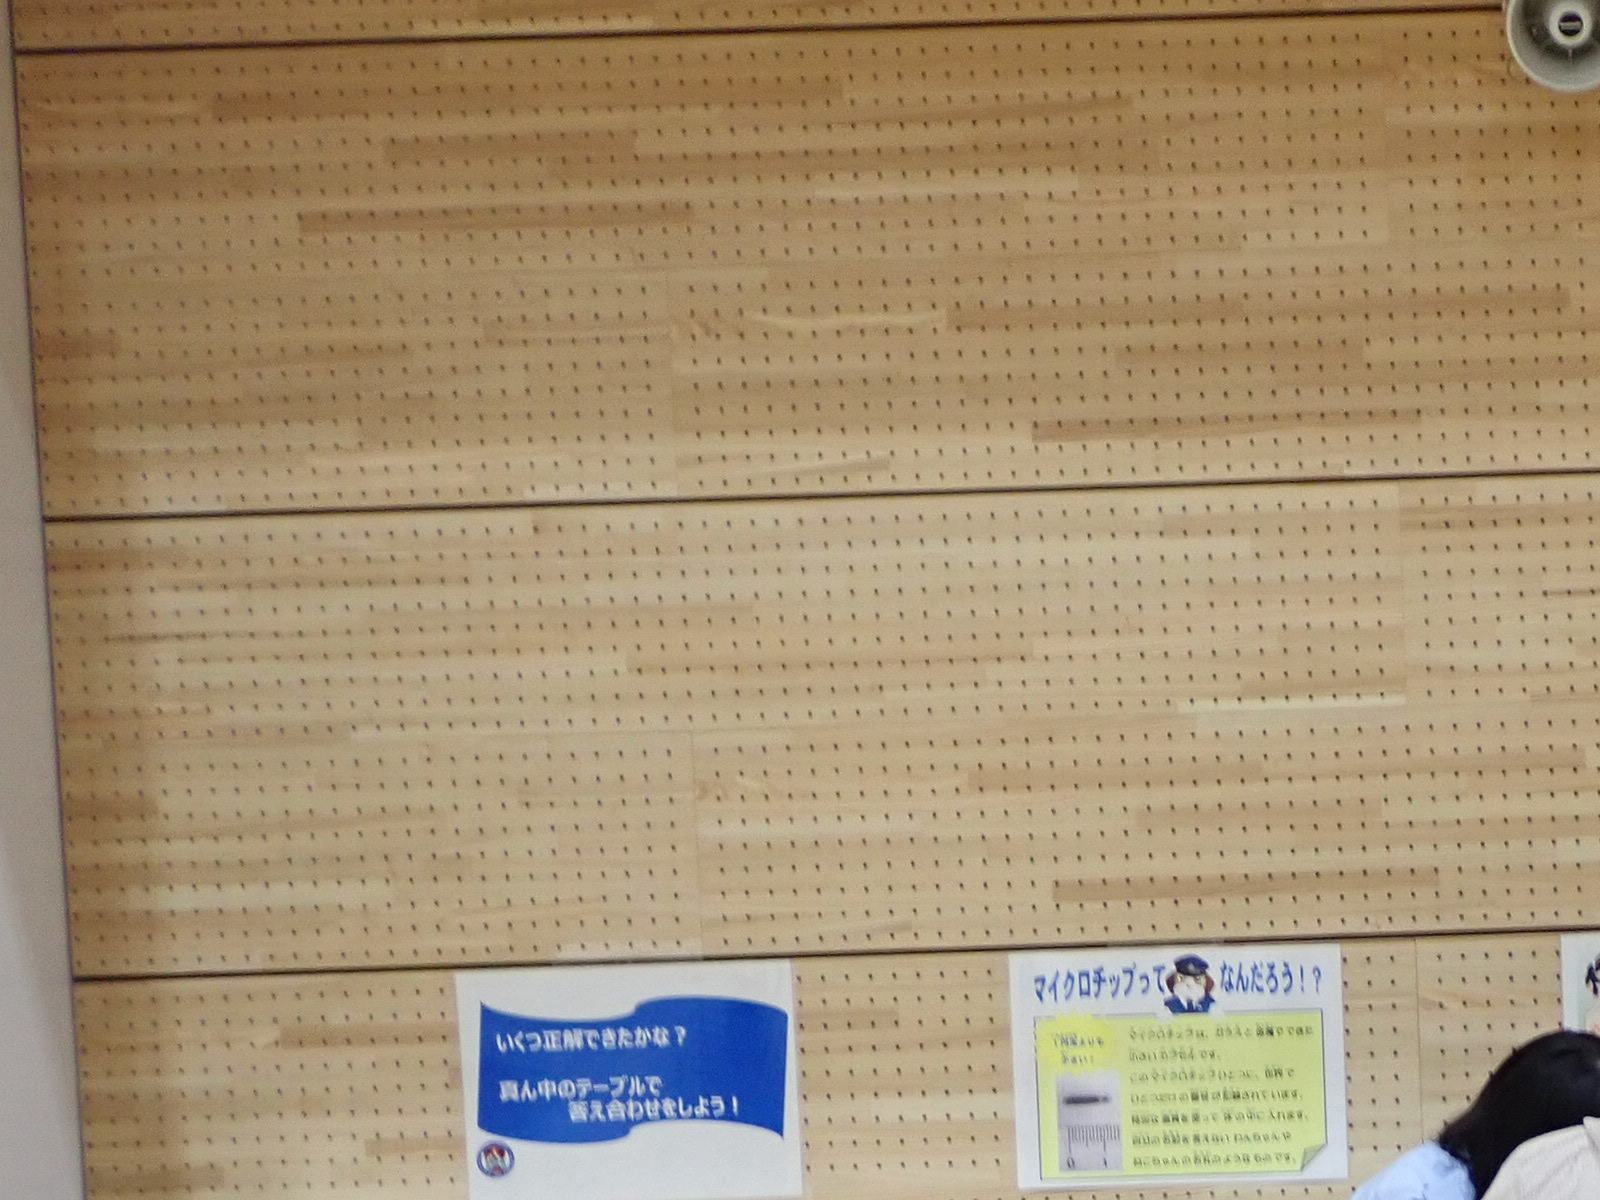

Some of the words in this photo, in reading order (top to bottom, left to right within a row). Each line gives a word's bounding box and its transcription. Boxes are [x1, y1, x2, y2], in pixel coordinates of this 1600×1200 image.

[1033, 964, 1165, 1005] マイクロチップって
[495, 1025, 687, 1053] いくつ正解できたかな？
[499, 1075, 663, 1102] 真ん中のテーブルで
[568, 1096, 739, 1123] 答え合わせをしよう！
